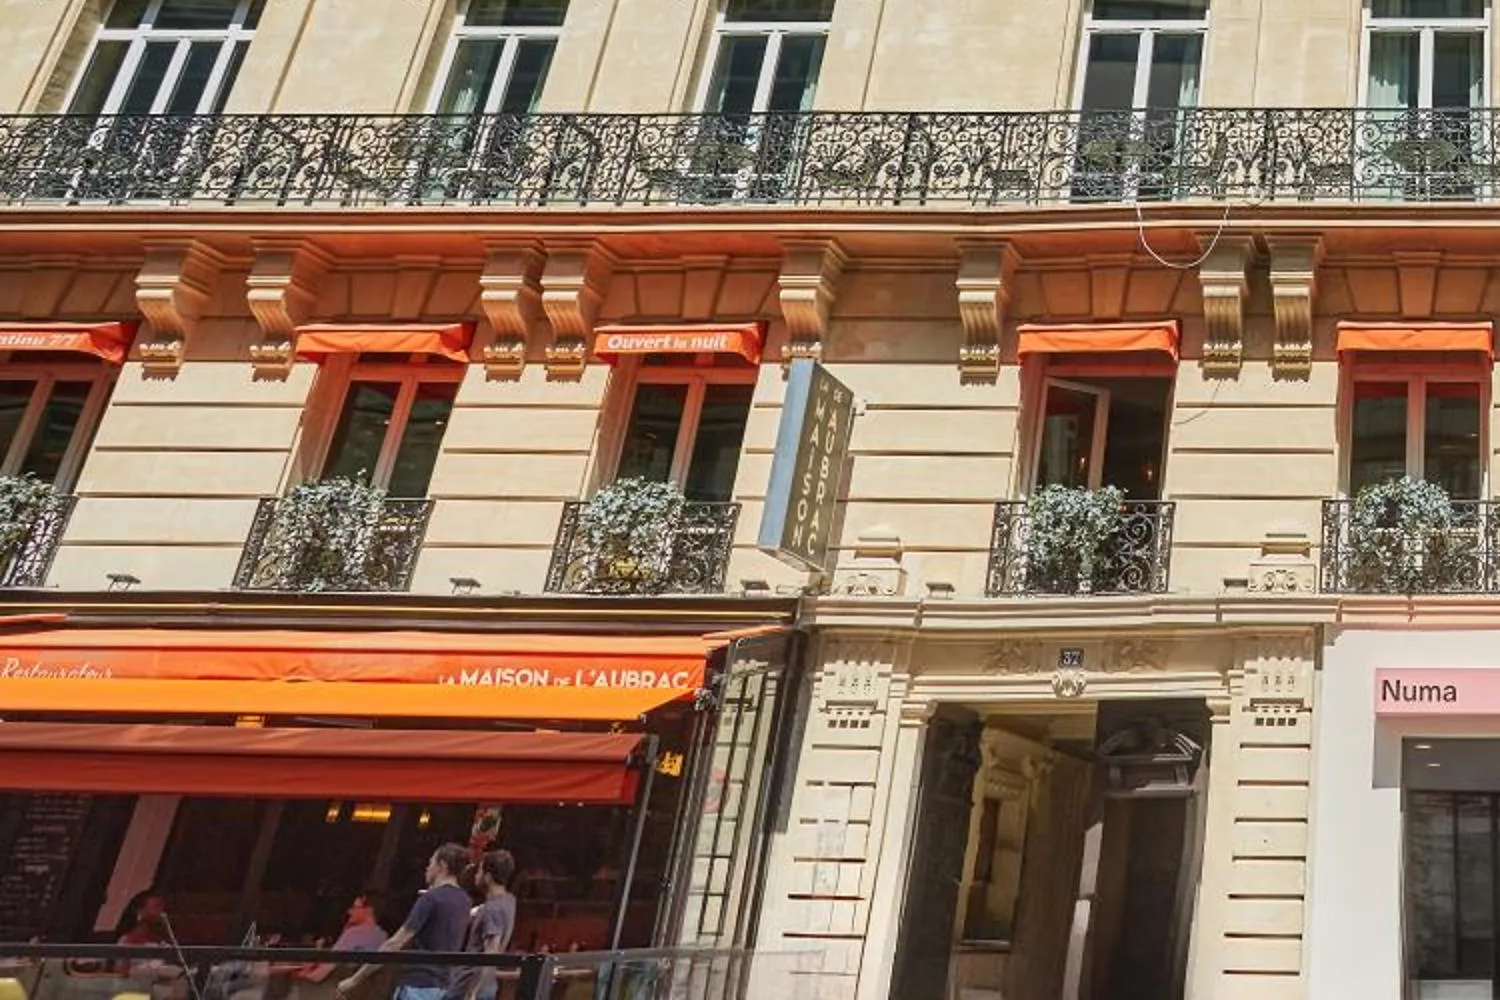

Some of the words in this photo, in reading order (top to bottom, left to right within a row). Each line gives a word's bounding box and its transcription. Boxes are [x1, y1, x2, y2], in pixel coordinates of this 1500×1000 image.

[608, 334, 671, 349] Ouvert
[691, 334, 727, 349] nuit
[792, 397, 827, 547] MAISON
[1063, 651, 1080, 665] 37
[460, 667, 549, 687] MAISON
[575, 669, 689, 688] L'AUBRAC
[1382, 679, 1457, 702] Numa
